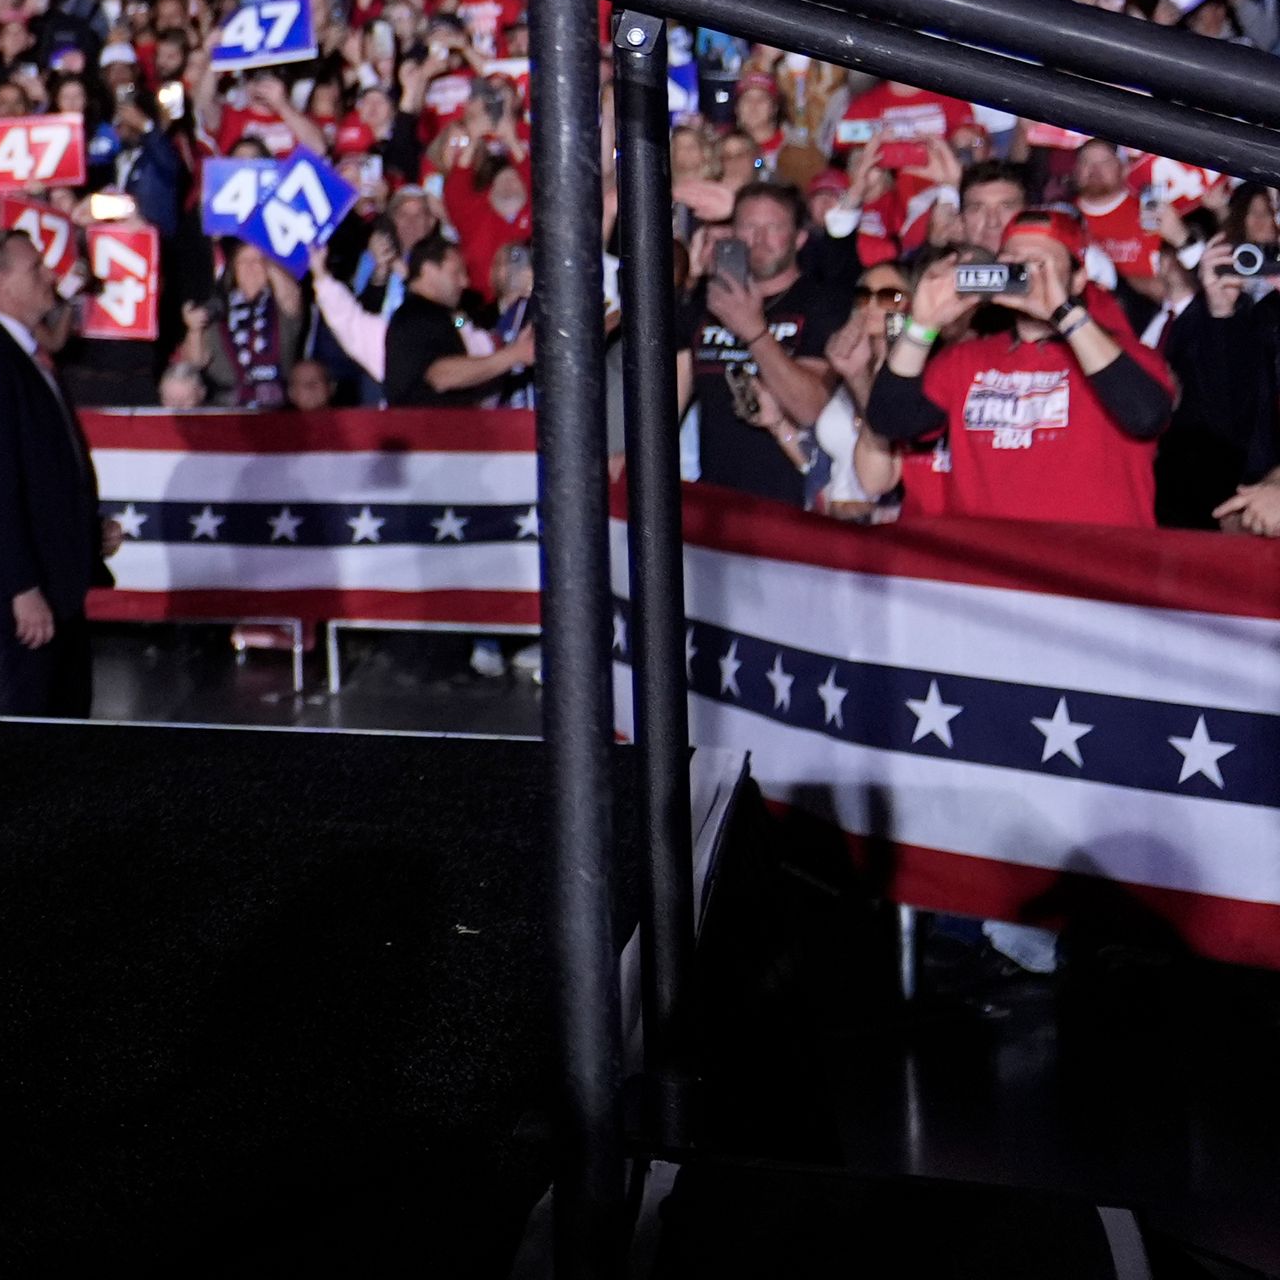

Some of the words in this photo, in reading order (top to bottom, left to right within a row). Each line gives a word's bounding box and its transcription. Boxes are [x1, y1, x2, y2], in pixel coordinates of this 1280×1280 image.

[222, 0, 300, 52] 47
[262, 159, 332, 257] 47
[94, 236, 148, 326] 47
